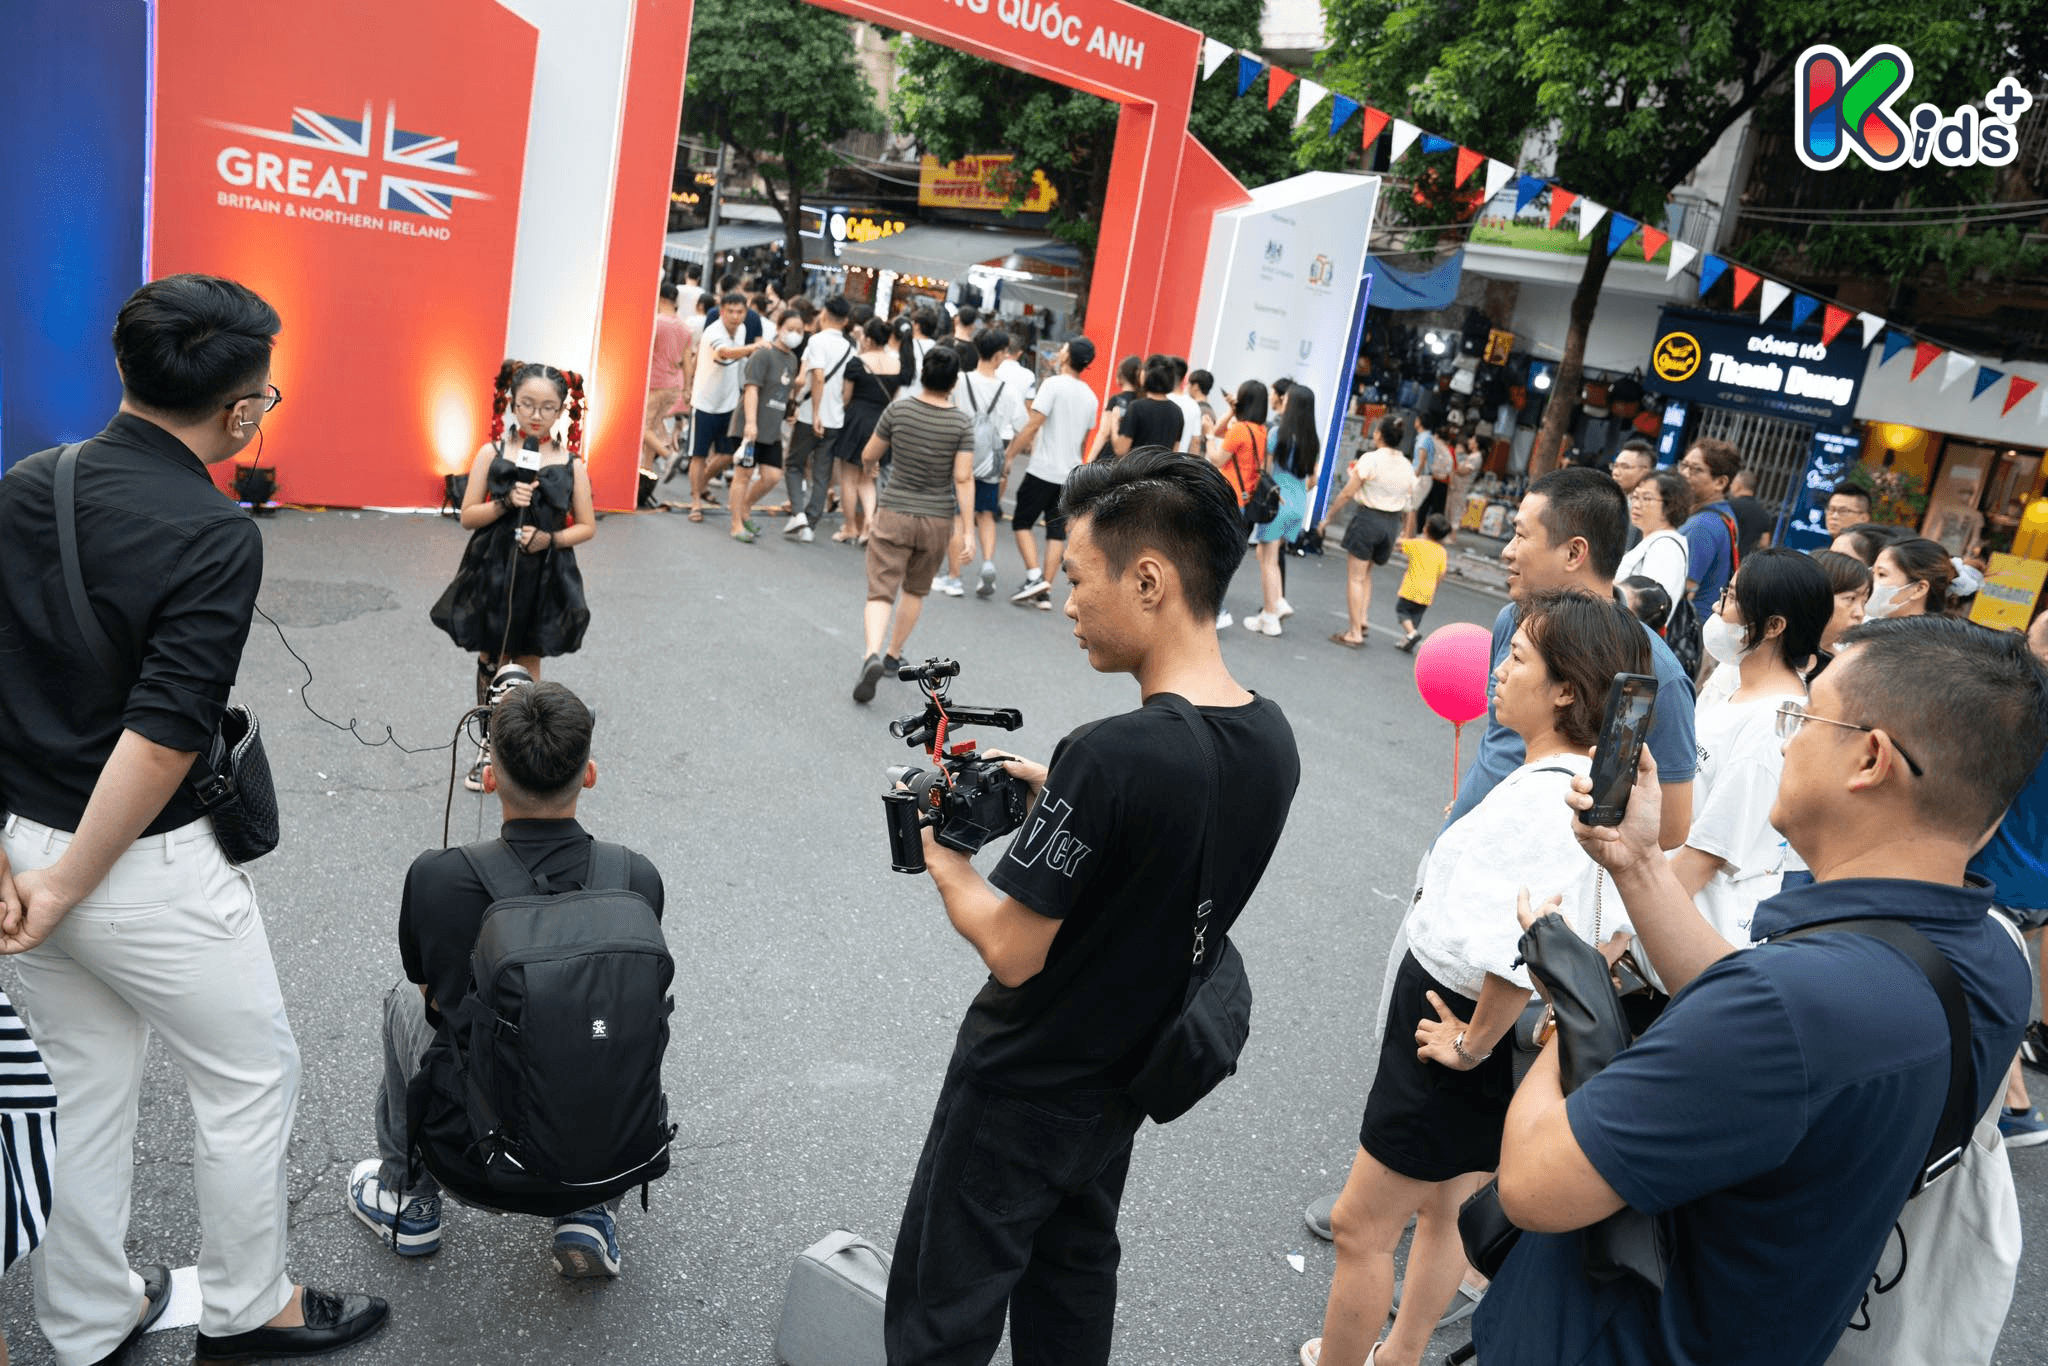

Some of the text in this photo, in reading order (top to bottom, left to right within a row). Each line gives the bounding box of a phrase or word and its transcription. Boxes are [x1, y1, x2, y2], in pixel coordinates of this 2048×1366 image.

[1085, 25, 1145, 71] ANH
[216, 146, 369, 206] GREAT
[217, 191, 451, 241] BRITAIN & NORTHERN IRELAND
[1708, 352, 1784, 392] Thanh
